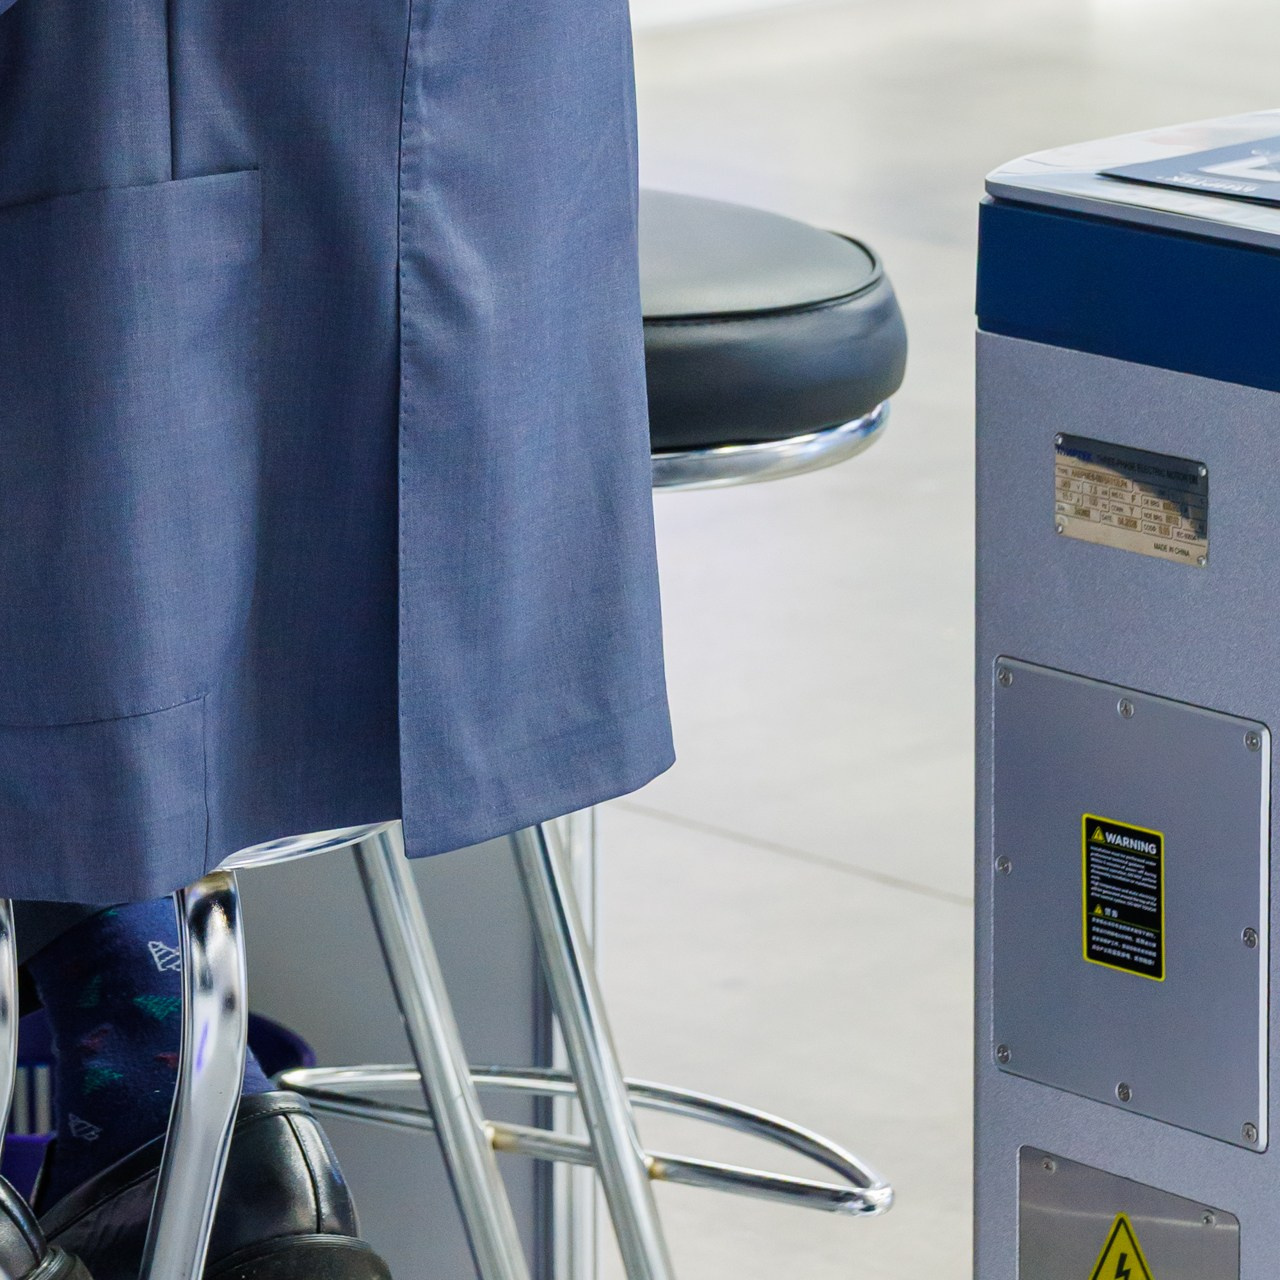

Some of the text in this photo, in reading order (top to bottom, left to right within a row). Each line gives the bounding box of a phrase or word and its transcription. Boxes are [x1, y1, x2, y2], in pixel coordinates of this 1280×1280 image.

[1154, 542, 1168, 552] MADE
[1175, 547, 1190, 556] CHINA
[1105, 832, 1157, 854] WARNING
